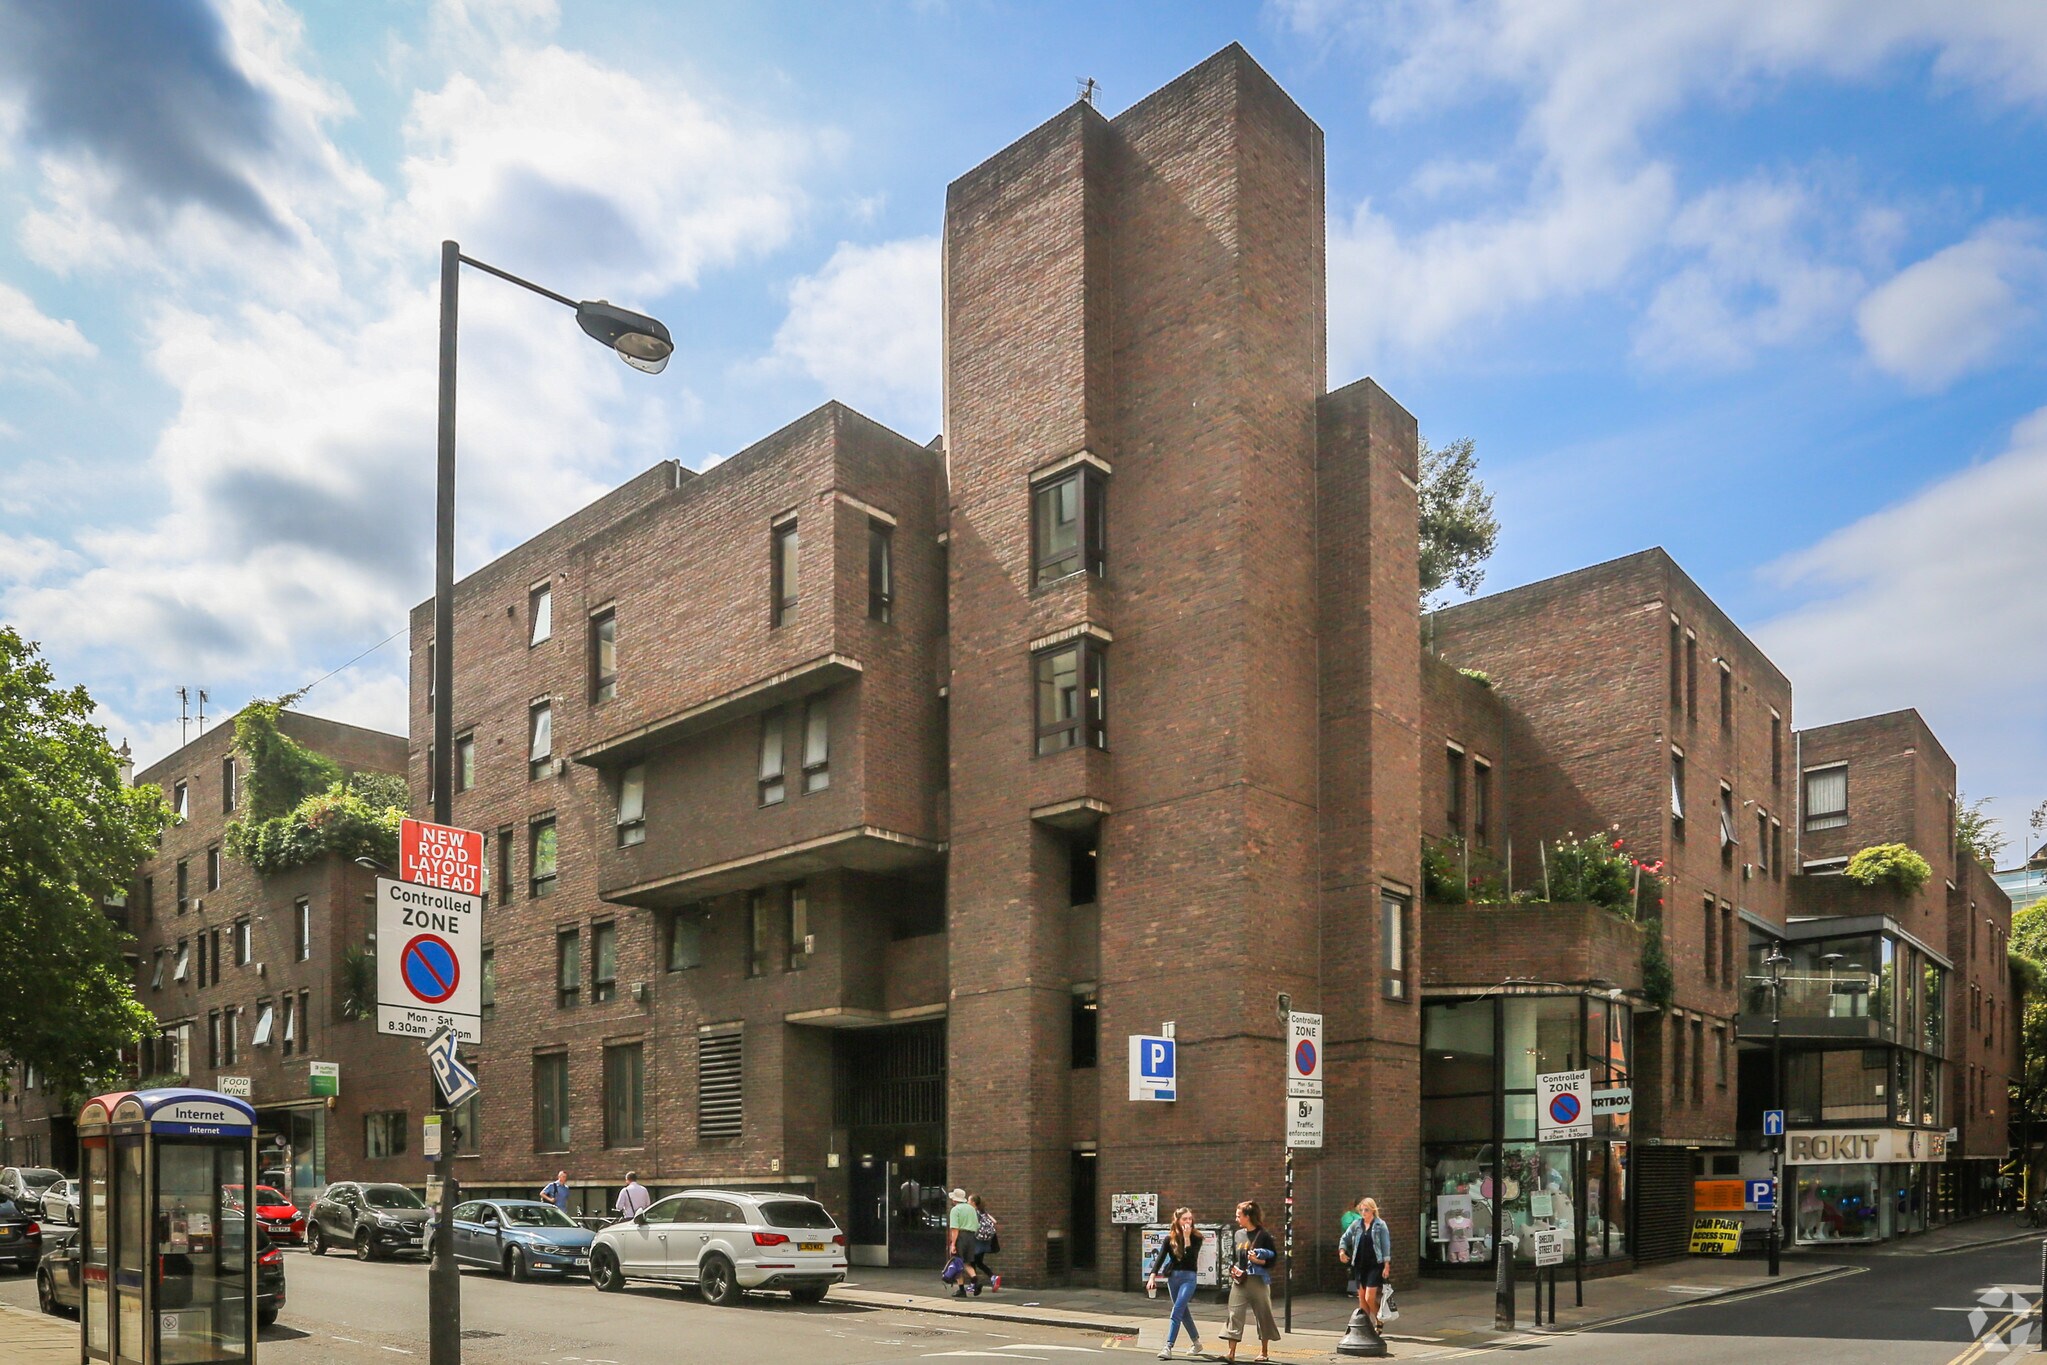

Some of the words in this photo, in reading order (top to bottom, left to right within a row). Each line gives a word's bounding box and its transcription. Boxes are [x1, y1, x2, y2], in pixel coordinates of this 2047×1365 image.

[422, 827, 465, 848] NEW
[418, 842, 468, 863] ROAD
[408, 855, 478, 879] LAYOUT
[414, 871, 474, 893] AHEAD
[390, 886, 471, 914] Controlled
[402, 908, 459, 934] ZONE
[407, 1012, 428, 1023] Mon
[438, 1016, 454, 1026] Sat
[1291, 1014, 1321, 1026] Controlled
[388, 1022, 426, 1034] 8.30am
[1295, 1026, 1316, 1037] ZONE
[1151, 1043, 1165, 1073] P
[431, 1050, 452, 1093] P
[1542, 1072, 1585, 1082] Controlled
[223, 1078, 248, 1086] FOOD
[1550, 1082, 1579, 1092] ZONE
[176, 1108, 225, 1120] Internet
[189, 1126, 220, 1134] Internet
[1296, 1121, 1314, 1129] Traffic
[1791, 1134, 1879, 1160] ROKIT
[1753, 1182, 1769, 1202] P
[1695, 1219, 1714, 1229] CAR
[1714, 1219, 1739, 1230] PARK
[1538, 1234, 1554, 1244] SHELTON
[1692, 1232, 1718, 1240] ACCESS
[1718, 1232, 1736, 1240] STILL
[1538, 1244, 1552, 1254] STREET
[1700, 1242, 1724, 1252] OPEN
